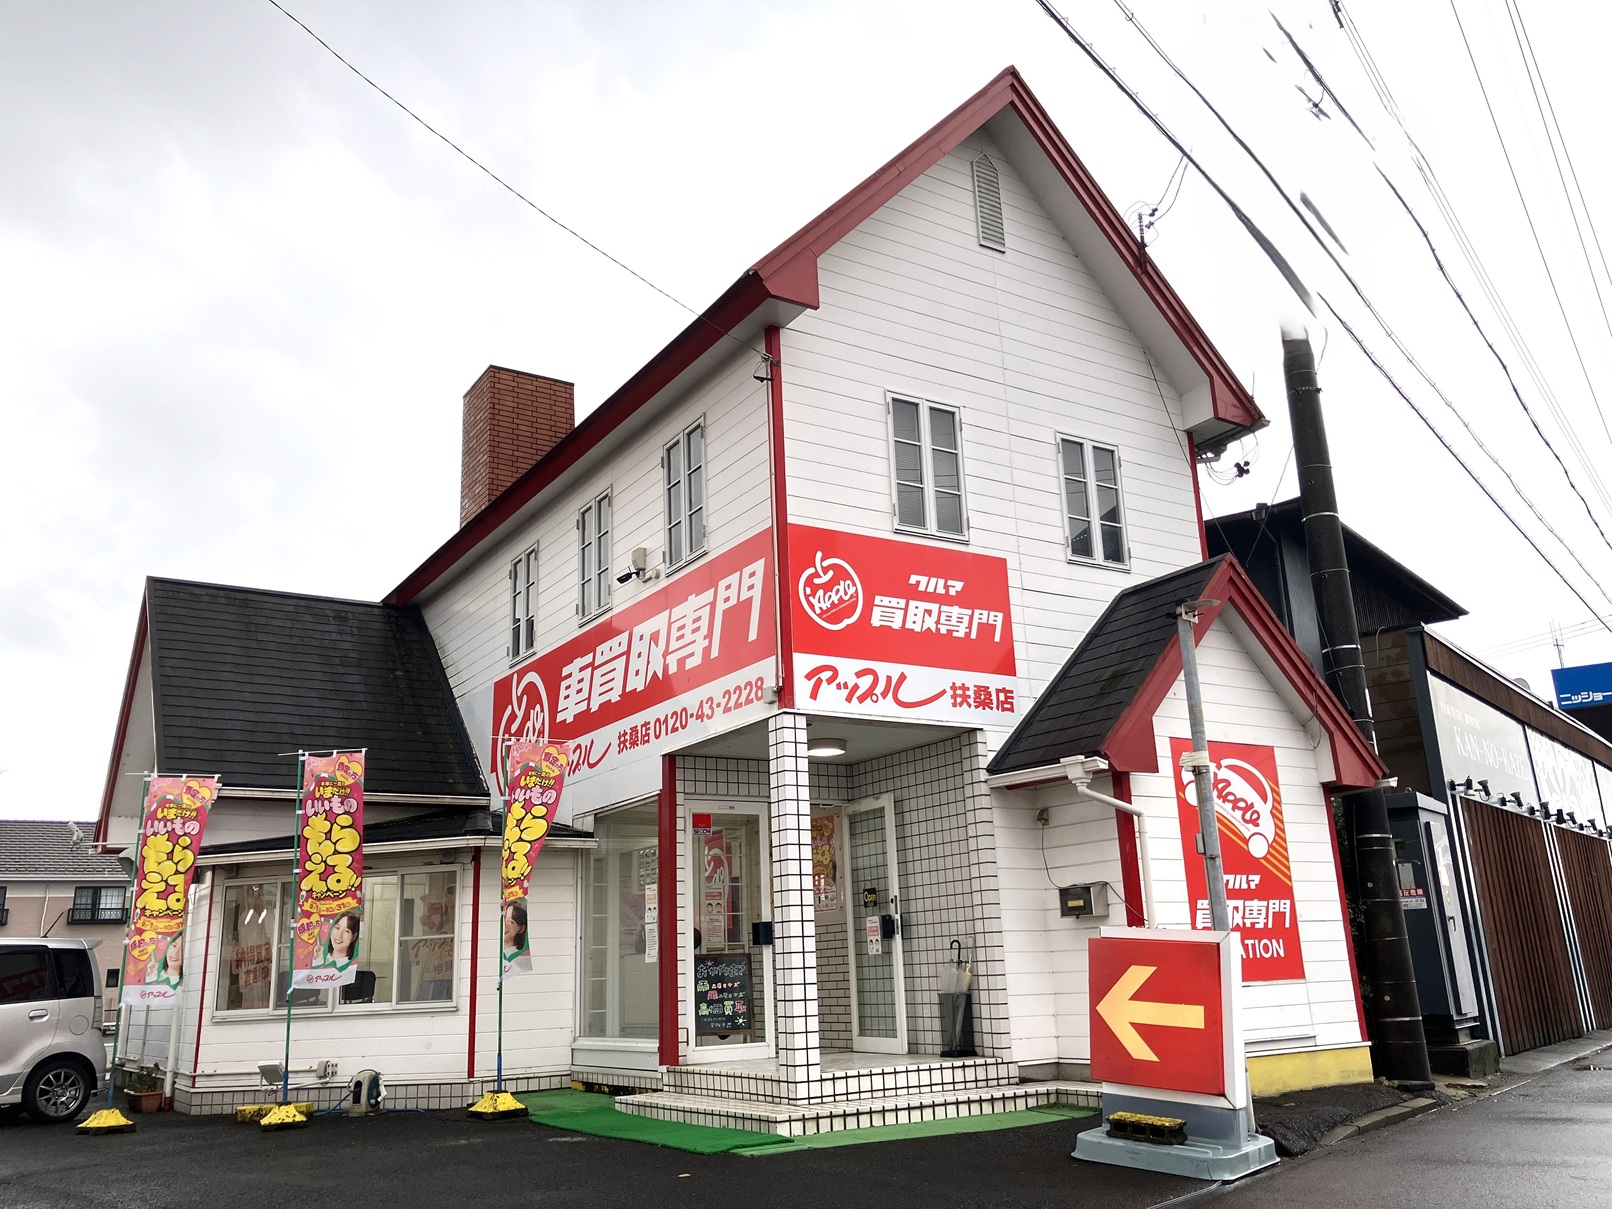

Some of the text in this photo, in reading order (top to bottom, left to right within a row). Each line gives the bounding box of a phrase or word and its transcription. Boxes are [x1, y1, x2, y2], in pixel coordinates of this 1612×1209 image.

[908, 574, 965, 596] クルマ
[555, 557, 766, 725] 車買取専門
[870, 595, 1004, 643] 買取専門
[803, 664, 1015, 713] アップル 扶桑店
[617, 721, 651, 755] 扶桑店
[653, 676, 764, 739] 0120-43-2228
[1453, 725, 1527, 780] KAN-NO-KAZE
[145, 817, 200, 837] いいもの
[305, 795, 358, 817] いいもの
[1223, 874, 1261, 889] クルマ
